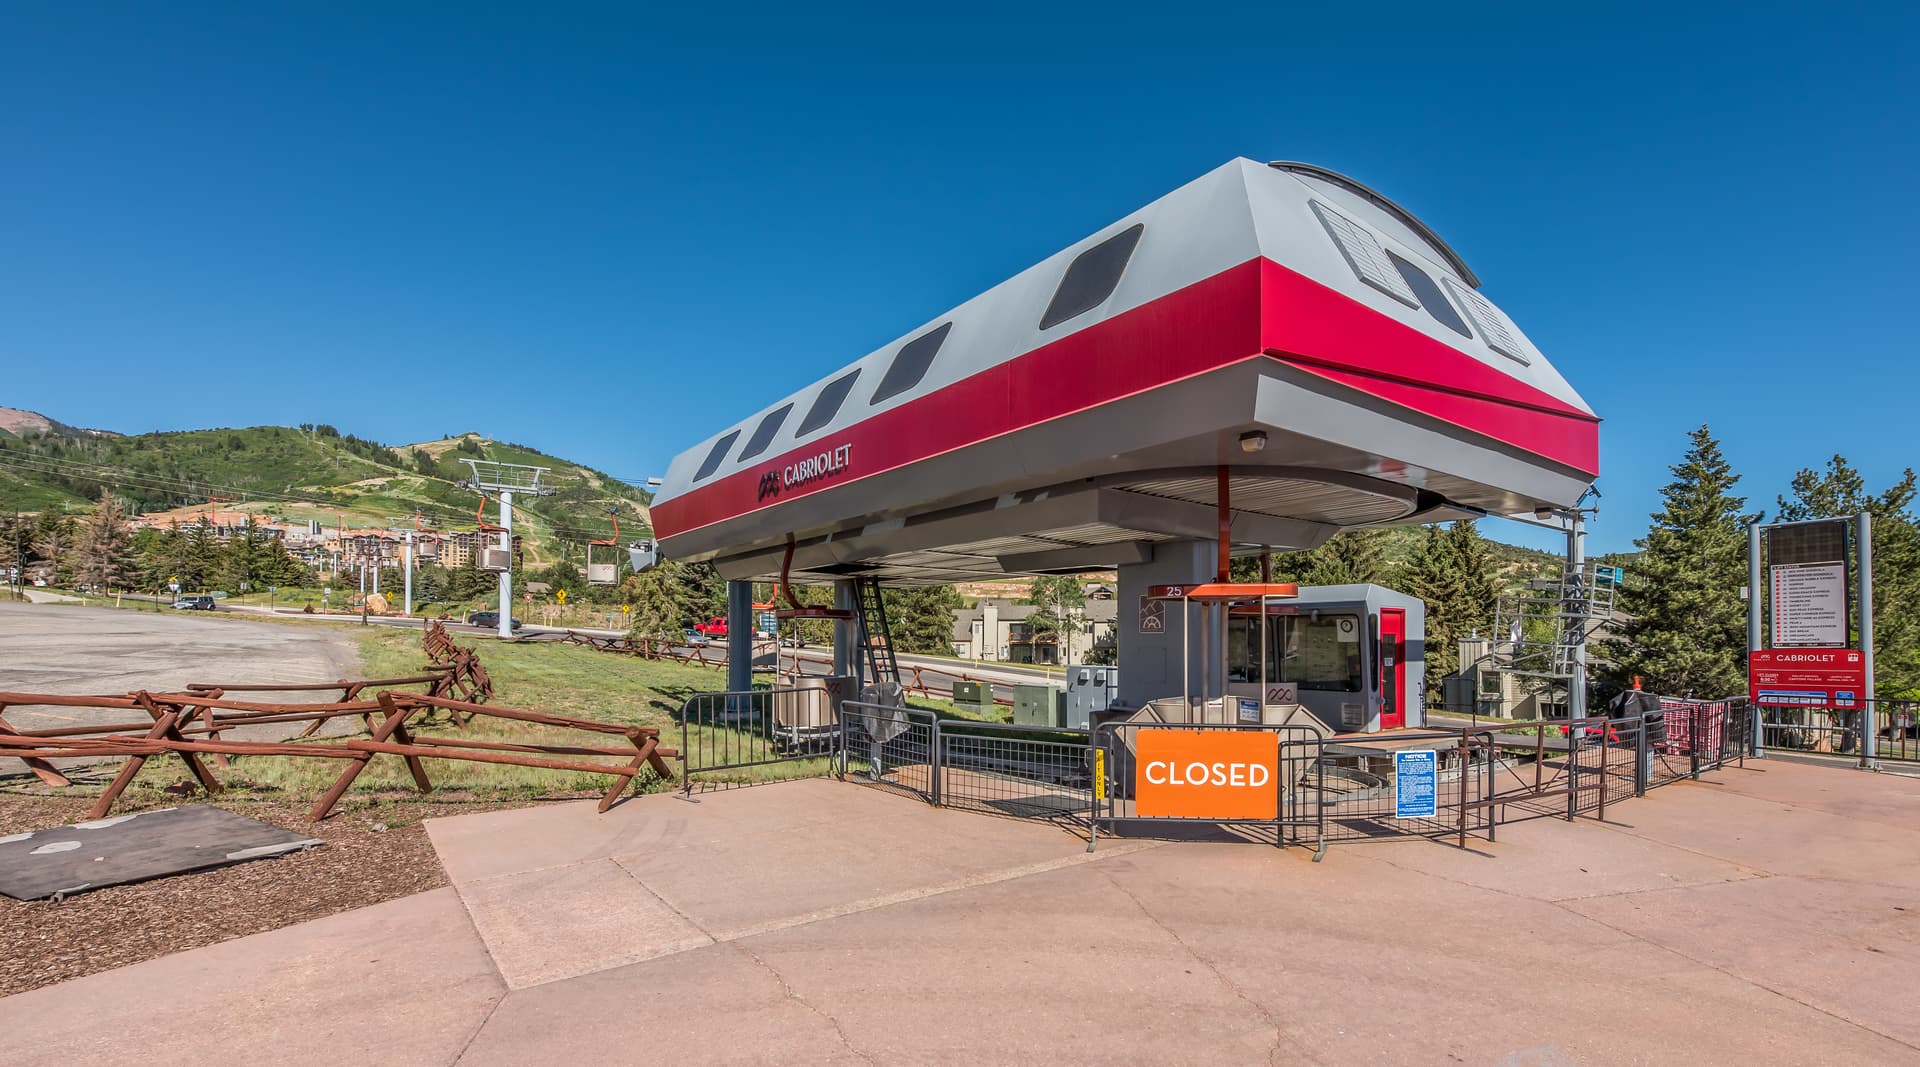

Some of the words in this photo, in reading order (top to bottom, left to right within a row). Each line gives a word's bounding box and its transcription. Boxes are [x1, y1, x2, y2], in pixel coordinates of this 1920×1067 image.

[784, 443, 852, 486] CABRIOLET
[1166, 586, 1182, 597] 25
[1776, 654, 1836, 662] CABRIOLET
[1145, 761, 1269, 787] CLOSED
